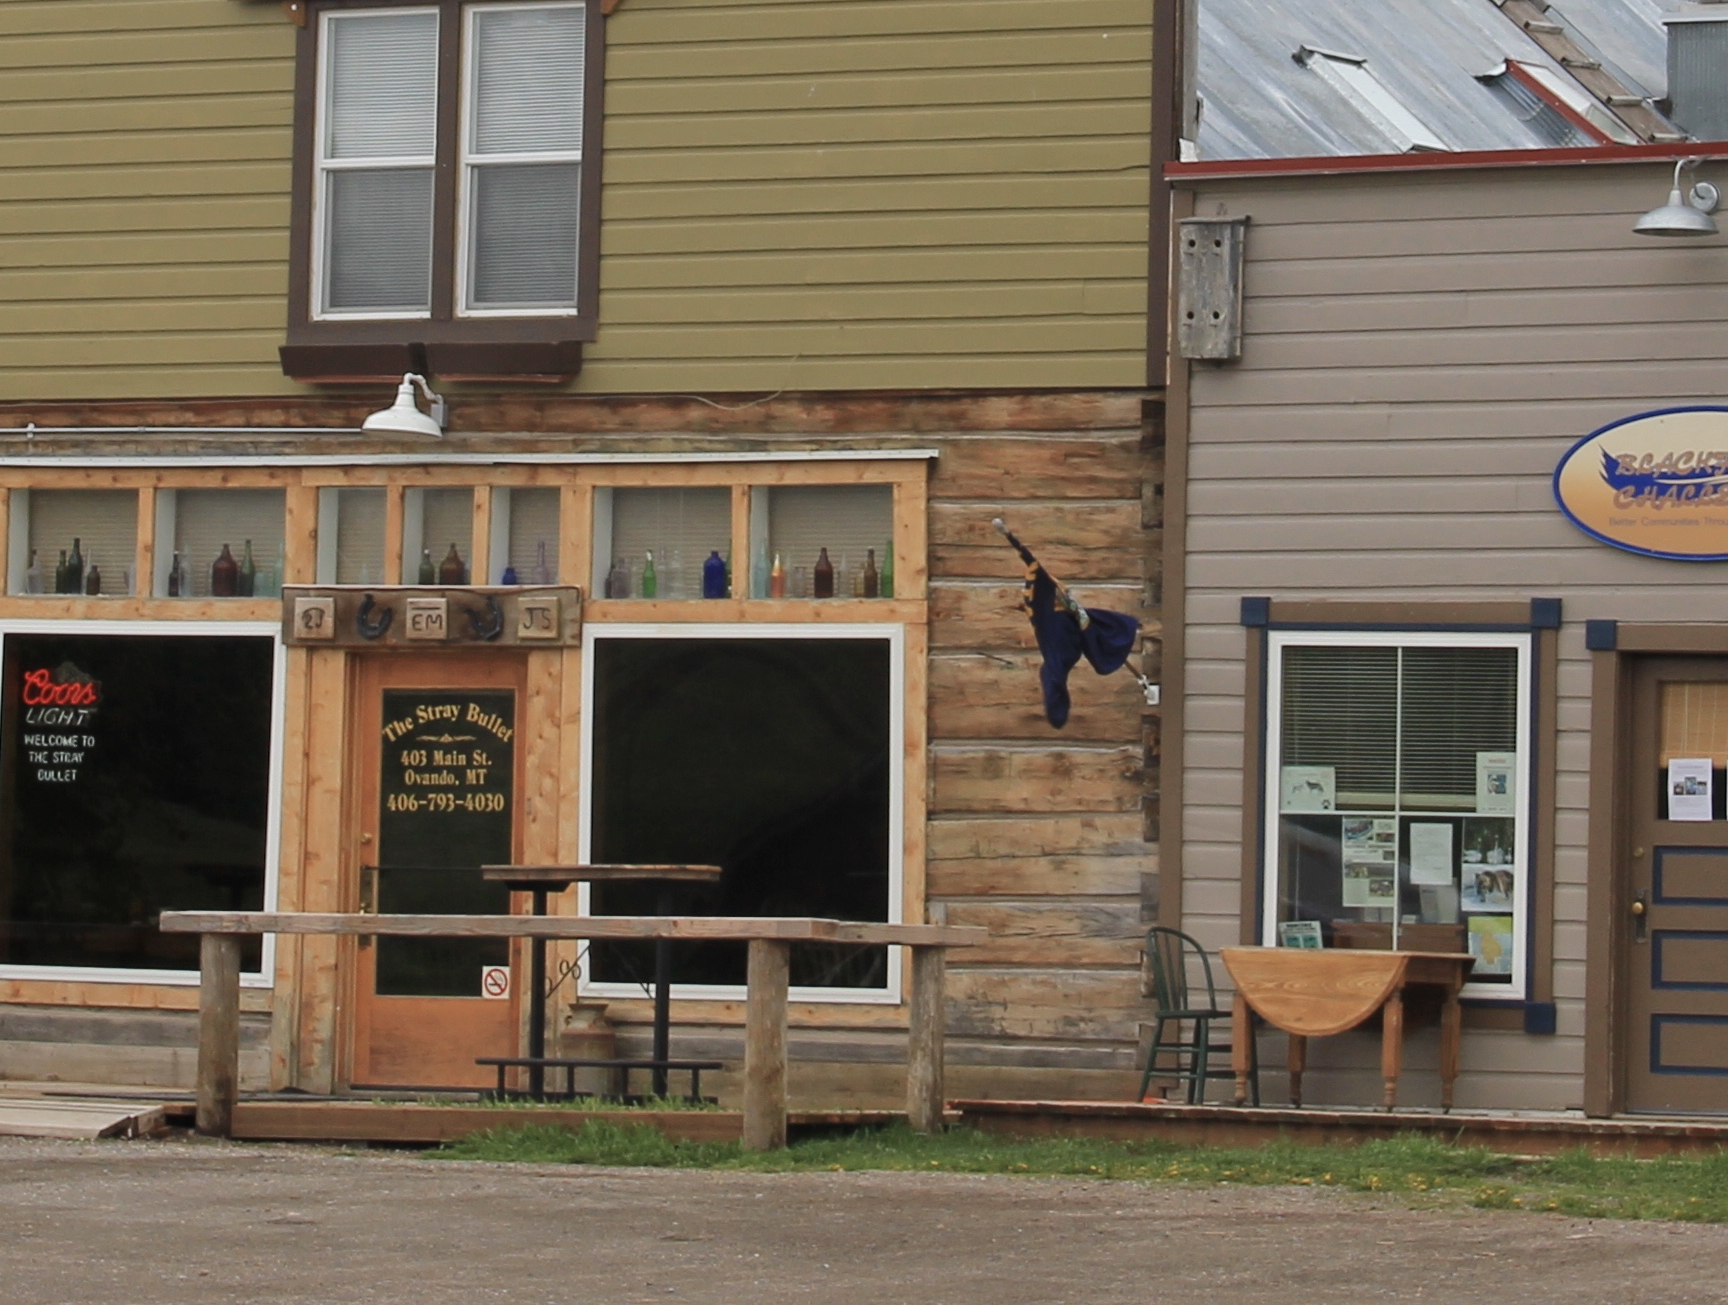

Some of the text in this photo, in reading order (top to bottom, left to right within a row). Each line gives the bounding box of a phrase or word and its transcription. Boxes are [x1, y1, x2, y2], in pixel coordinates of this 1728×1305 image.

[1640, 517, 1700, 527] Communities
[23, 668, 97, 705] Coors
[25, 707, 90, 726] LIGHT
[382, 702, 514, 742] The Stray Bullet
[24, 734, 96, 747] WELCOME TO
[28, 751, 49, 764] THE
[401, 749, 493, 766] 403 Main St.
[405, 769, 488, 786] Ovando, MT
[387, 793, 505, 812] 406-793-4030
